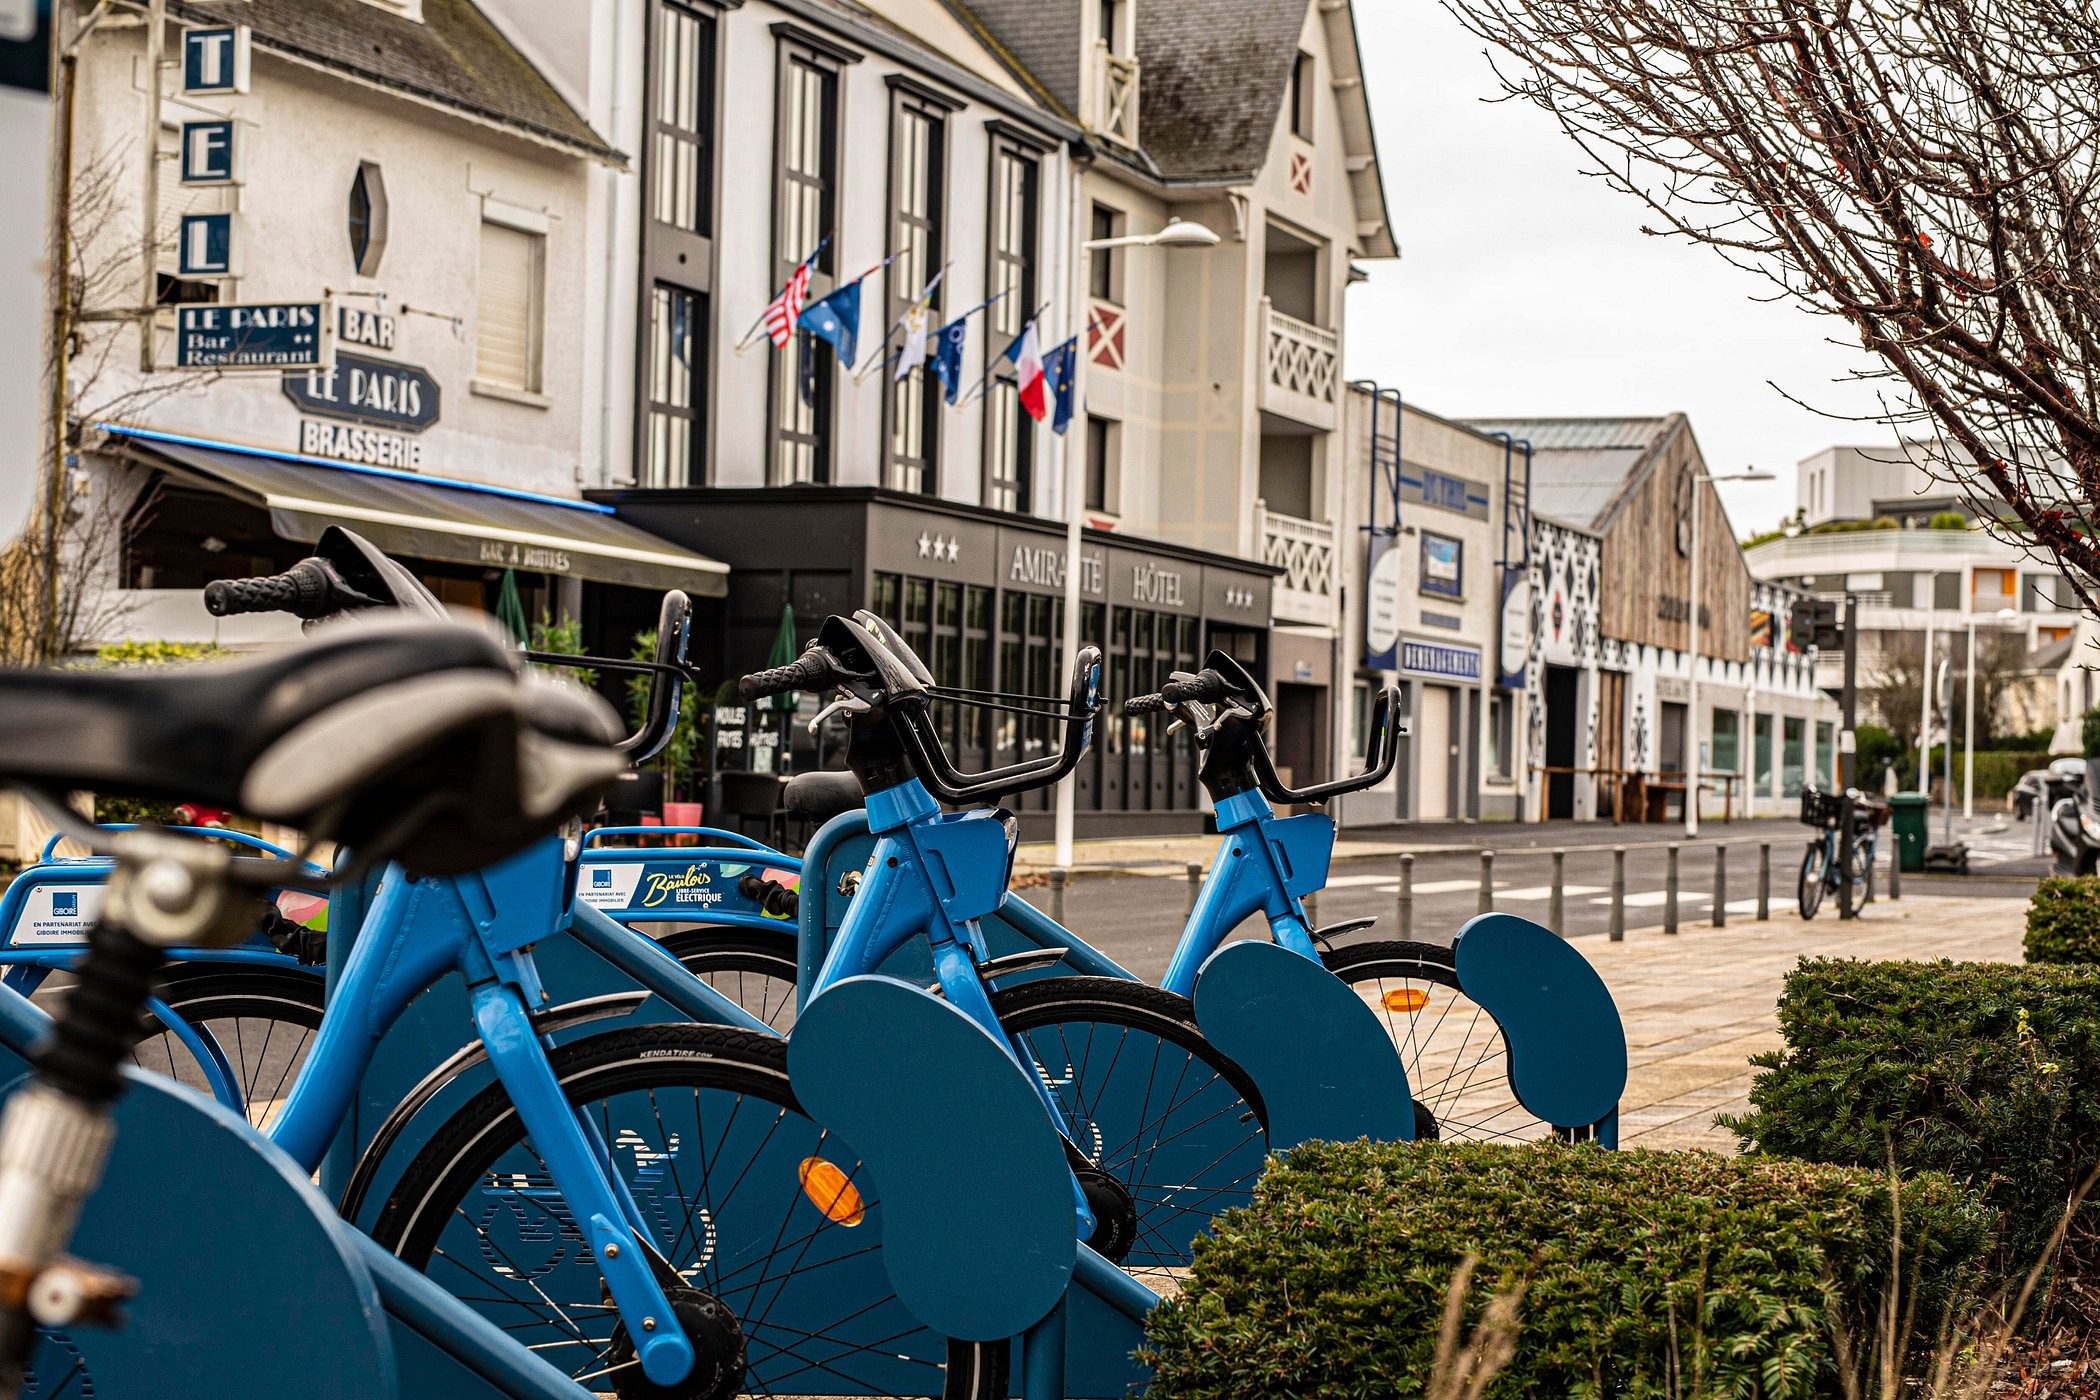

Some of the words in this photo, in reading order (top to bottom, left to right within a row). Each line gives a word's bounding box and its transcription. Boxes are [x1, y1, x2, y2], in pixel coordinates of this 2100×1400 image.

[185, 308, 220, 331] LE
[230, 306, 315, 329] PARIS
[344, 308, 395, 350] BAR
[186, 349, 313, 366] Restaurant
[187, 333, 231, 349] Bar
[306, 364, 340, 403] LE
[350, 369, 421, 417] PARIS
[302, 422, 421, 471] BRASSERIE
[1010, 544, 1103, 595] AMIRATÉ
[1132, 561, 1185, 607] HÔTEL
[641, 864, 711, 907] Baulois
[676, 892, 722, 904] ÉLECTRIQUE
